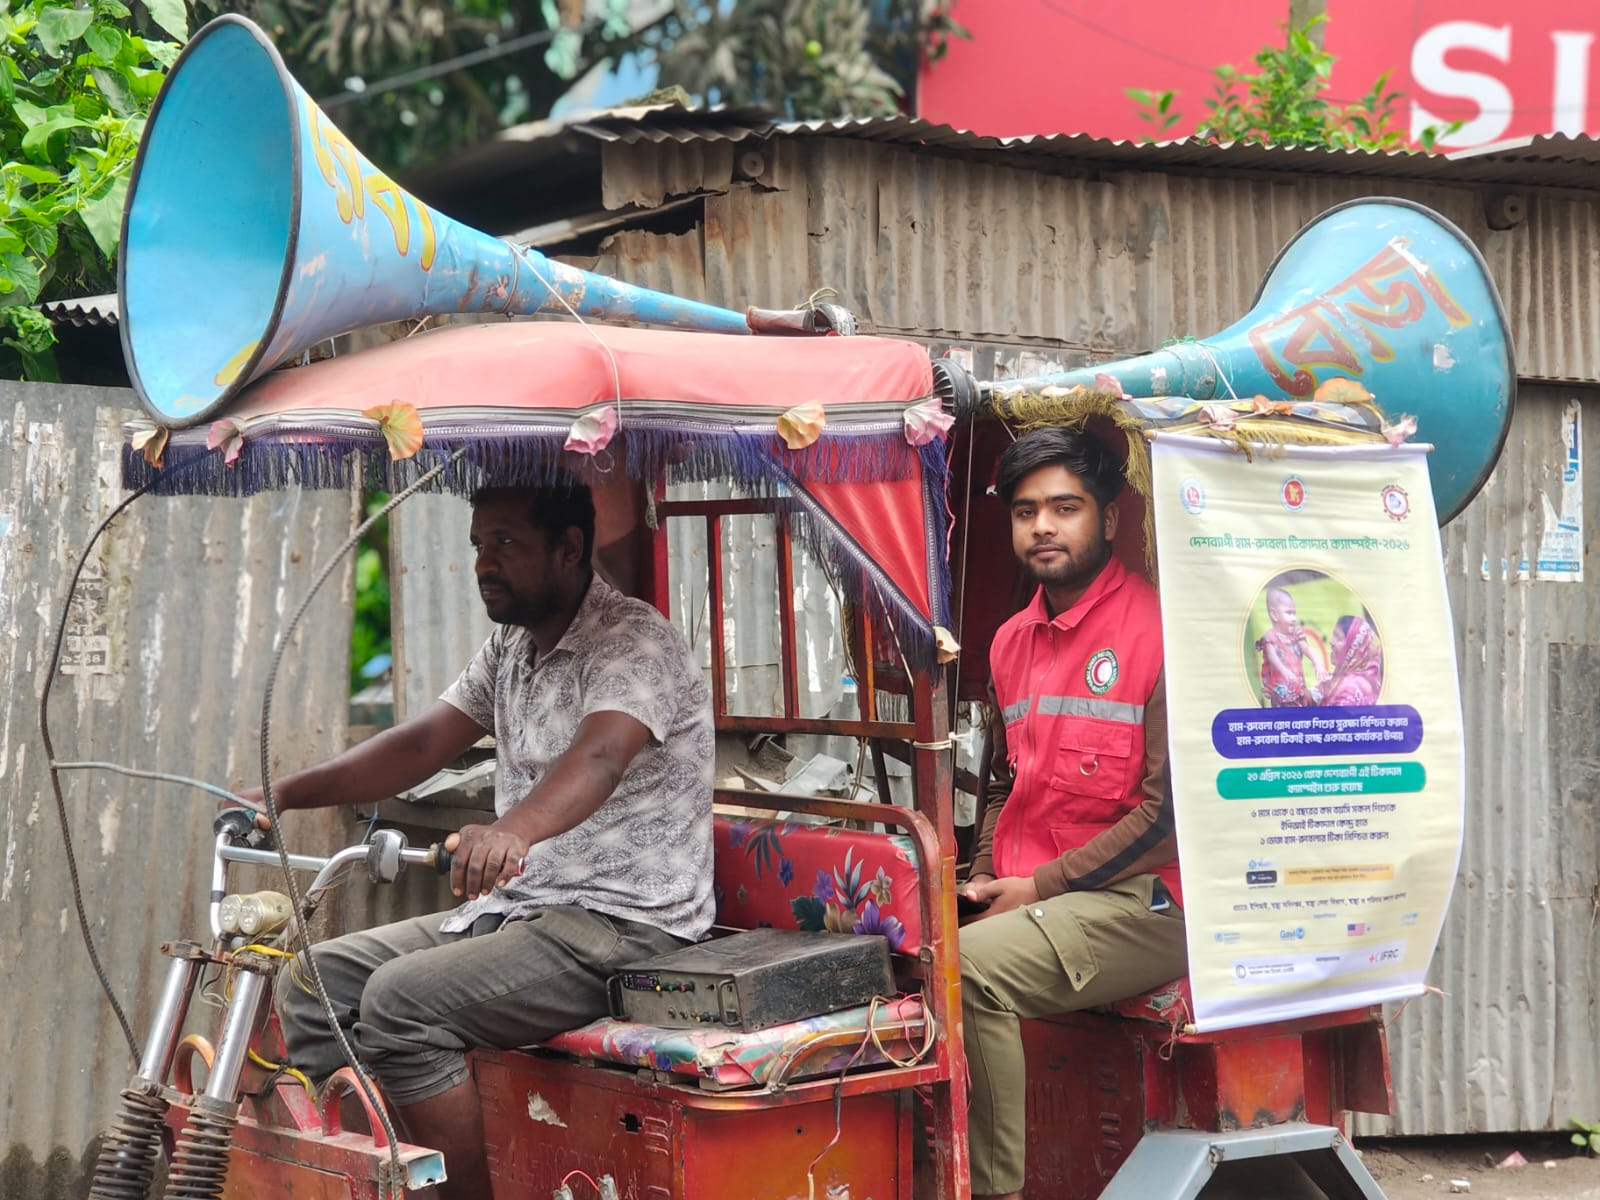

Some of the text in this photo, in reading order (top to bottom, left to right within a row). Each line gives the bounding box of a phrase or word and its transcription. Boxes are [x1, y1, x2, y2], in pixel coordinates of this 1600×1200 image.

[1189, 534, 1410, 550] দেশব্যাপী হাম-রুবেলা টিকাদান ক্যাম্পেইন-২০২৬
[1228, 721, 1273, 732] হাম-রুবেলা
[1274, 720, 1291, 731] রোগ
[1291, 719, 1312, 730] থেকে
[1312, 716, 1335, 729] শিশুর
[1360, 715, 1386, 728] নিশ্চিত
[1236, 735, 1280, 746] হাম-রুবেলা
[1280, 732, 1304, 744] টিকাই
[1323, 733, 1353, 743] একমাত্র
[1353, 729, 1383, 742] কার্যকর
